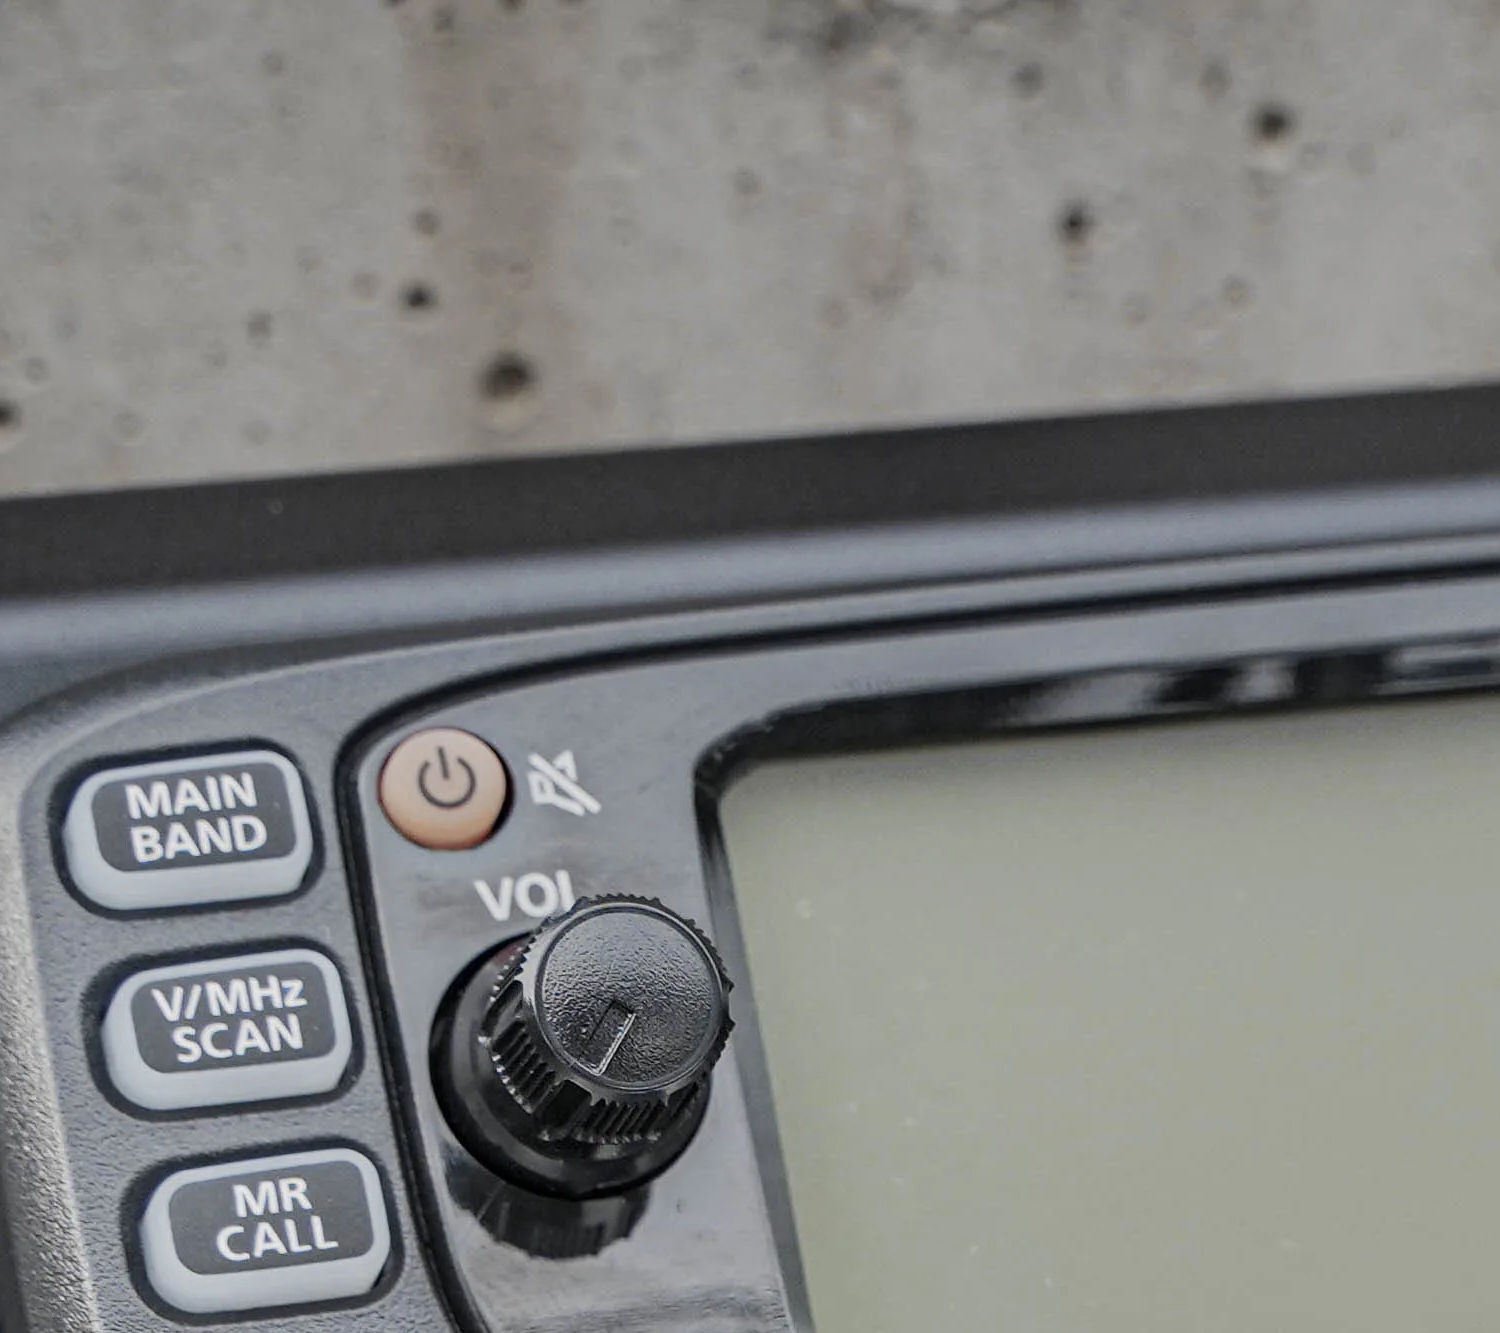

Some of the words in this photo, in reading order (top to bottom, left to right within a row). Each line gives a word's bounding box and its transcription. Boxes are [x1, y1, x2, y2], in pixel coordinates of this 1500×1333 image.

[124, 772, 257, 819] MAIN
[130, 814, 267, 863] BAND
[151, 974, 307, 1022] V/MHz
[172, 1012, 303, 1063] SCAN
[232, 1177, 313, 1218] MR
[216, 1215, 339, 1261] CALL
